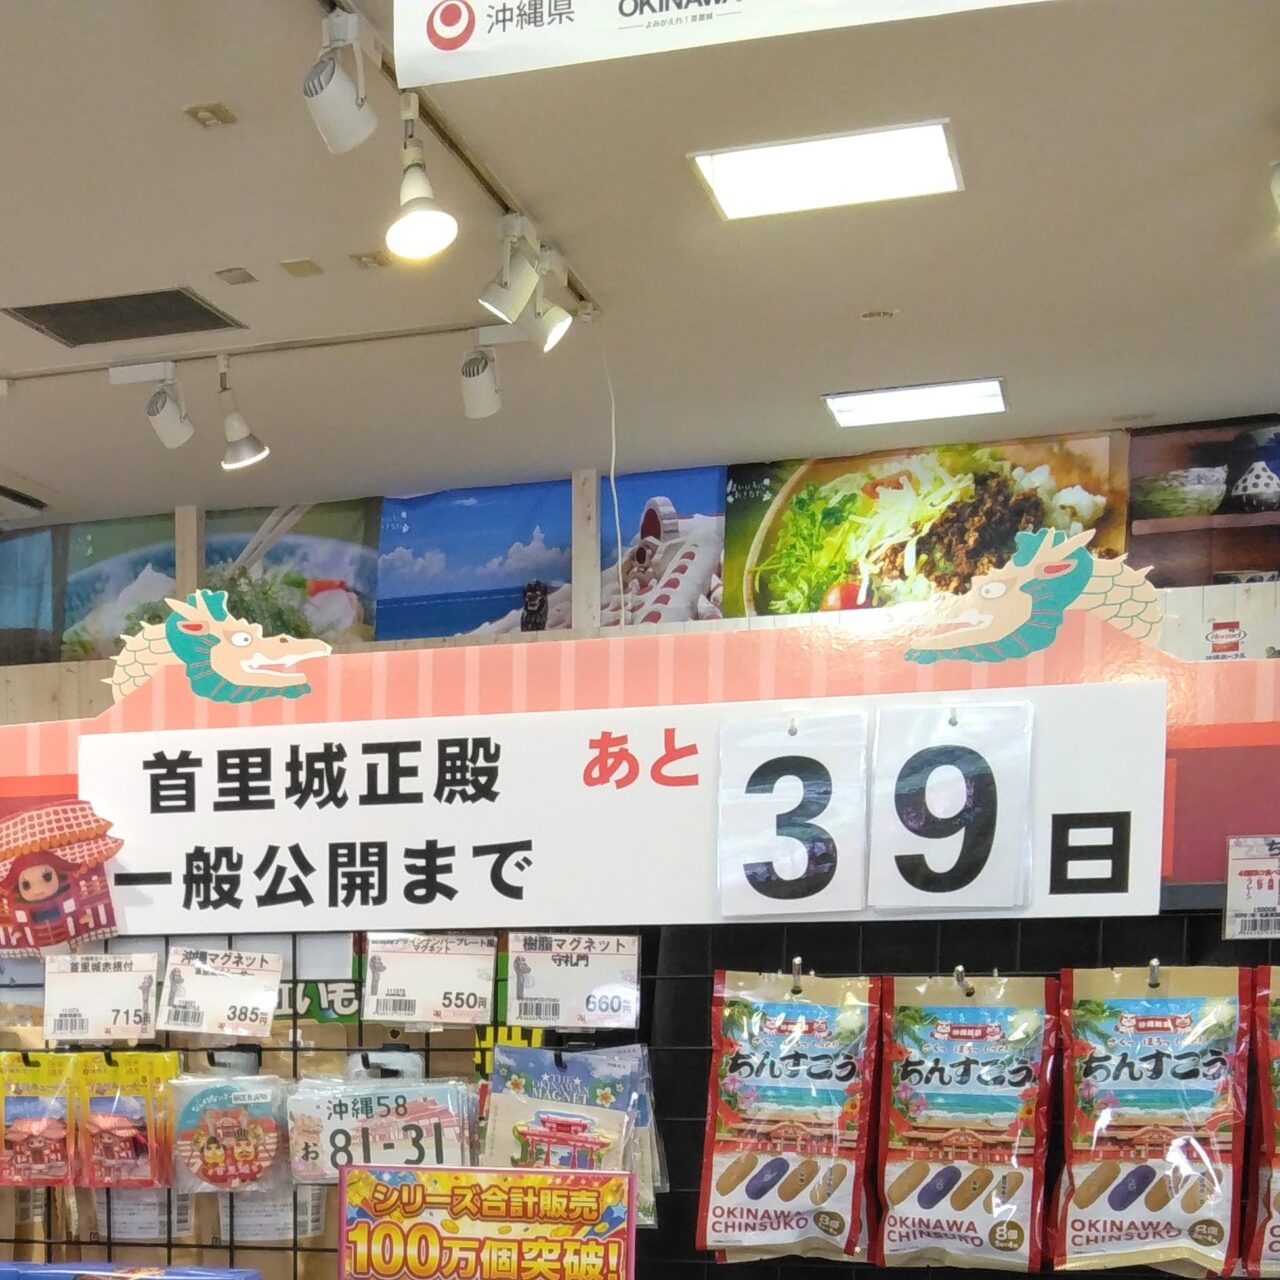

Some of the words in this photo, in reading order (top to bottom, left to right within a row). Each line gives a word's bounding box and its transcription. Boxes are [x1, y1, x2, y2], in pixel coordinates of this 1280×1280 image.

[486, 0, 575, 34] 沖縄県
[142, 737, 501, 814] 首里城正殿
[582, 728, 700, 789] あと
[1050, 811, 1131, 895] 日
[115, 839, 533, 910] 一般公開まで
[522, 935, 626, 953] 樹脂マグネット
[727, 1050, 858, 1082] ちんすこう
[900, 1056, 1036, 1087] ちんすこう
[1082, 1049, 1227, 1082] ちんすこう
[301, 1141, 320, 1160] お
[330, 1122, 444, 1170] 81-31
[373, 1183, 602, 1221] シリーズ合計販売
[712, 1205, 802, 1221] OKINAWA
[712, 1216, 809, 1233] CHINSUKO
[887, 1229, 983, 1248] CHINSUKO
[888, 1215, 977, 1233] OKINAWA
[1071, 1219, 1175, 1233] OKINAWA
[1071, 1227, 1182, 1247] CHINSUKO
